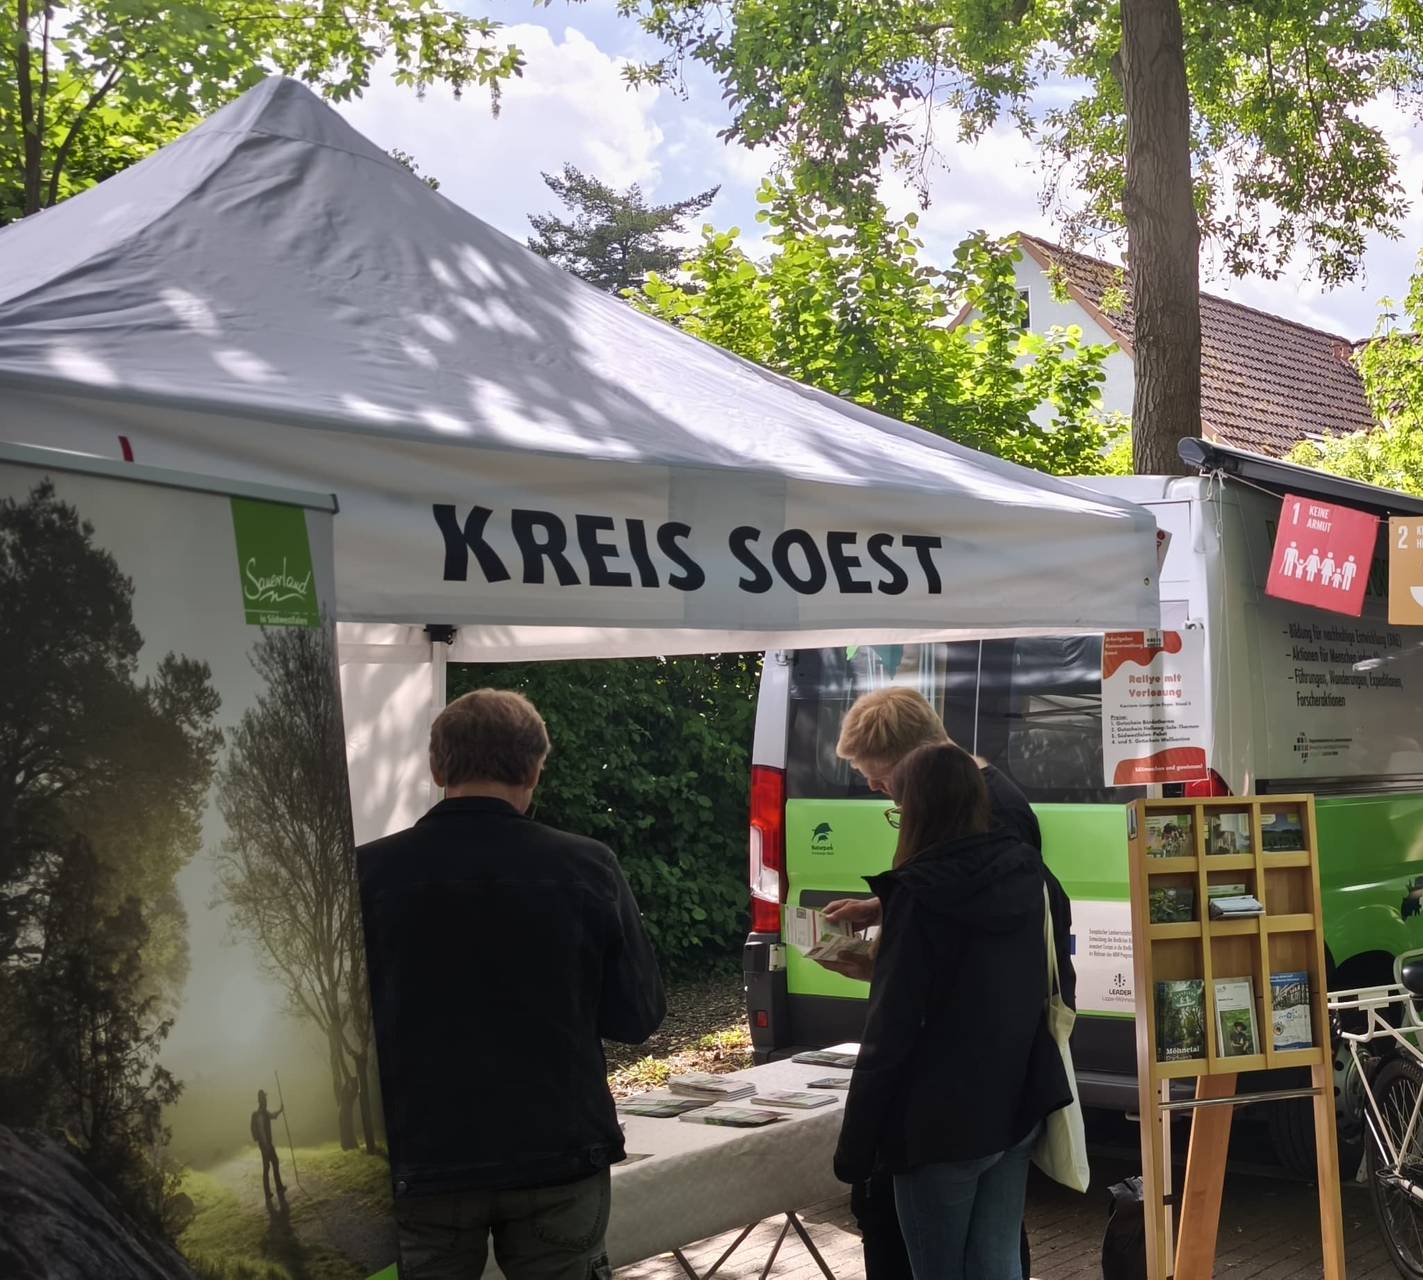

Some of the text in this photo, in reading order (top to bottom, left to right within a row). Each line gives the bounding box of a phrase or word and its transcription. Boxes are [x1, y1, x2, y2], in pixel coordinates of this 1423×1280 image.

[1292, 502, 1329, 526] 1 KEINE
[1306, 519, 1333, 534] ARMUT
[1397, 525, 1409, 549] 2
[432, 503, 943, 596] KREIS SOEST
[244, 557, 312, 600] Sauerland
[1293, 645, 1319, 661] Aktionen
[1319, 646, 1329, 662] für
[1329, 647, 1357, 664] Menschen
[1128, 674, 1182, 684] Rallye mit
[1295, 667, 1328, 688] Führungen,
[1329, 670, 1368, 688] Wanderungen,
[1128, 687, 1183, 698] Verlosung
[1296, 691, 1346, 706] Forscheraktionen
[1108, 988, 1132, 996] LEADER
[1165, 1046, 1200, 1055] Möhnetal
